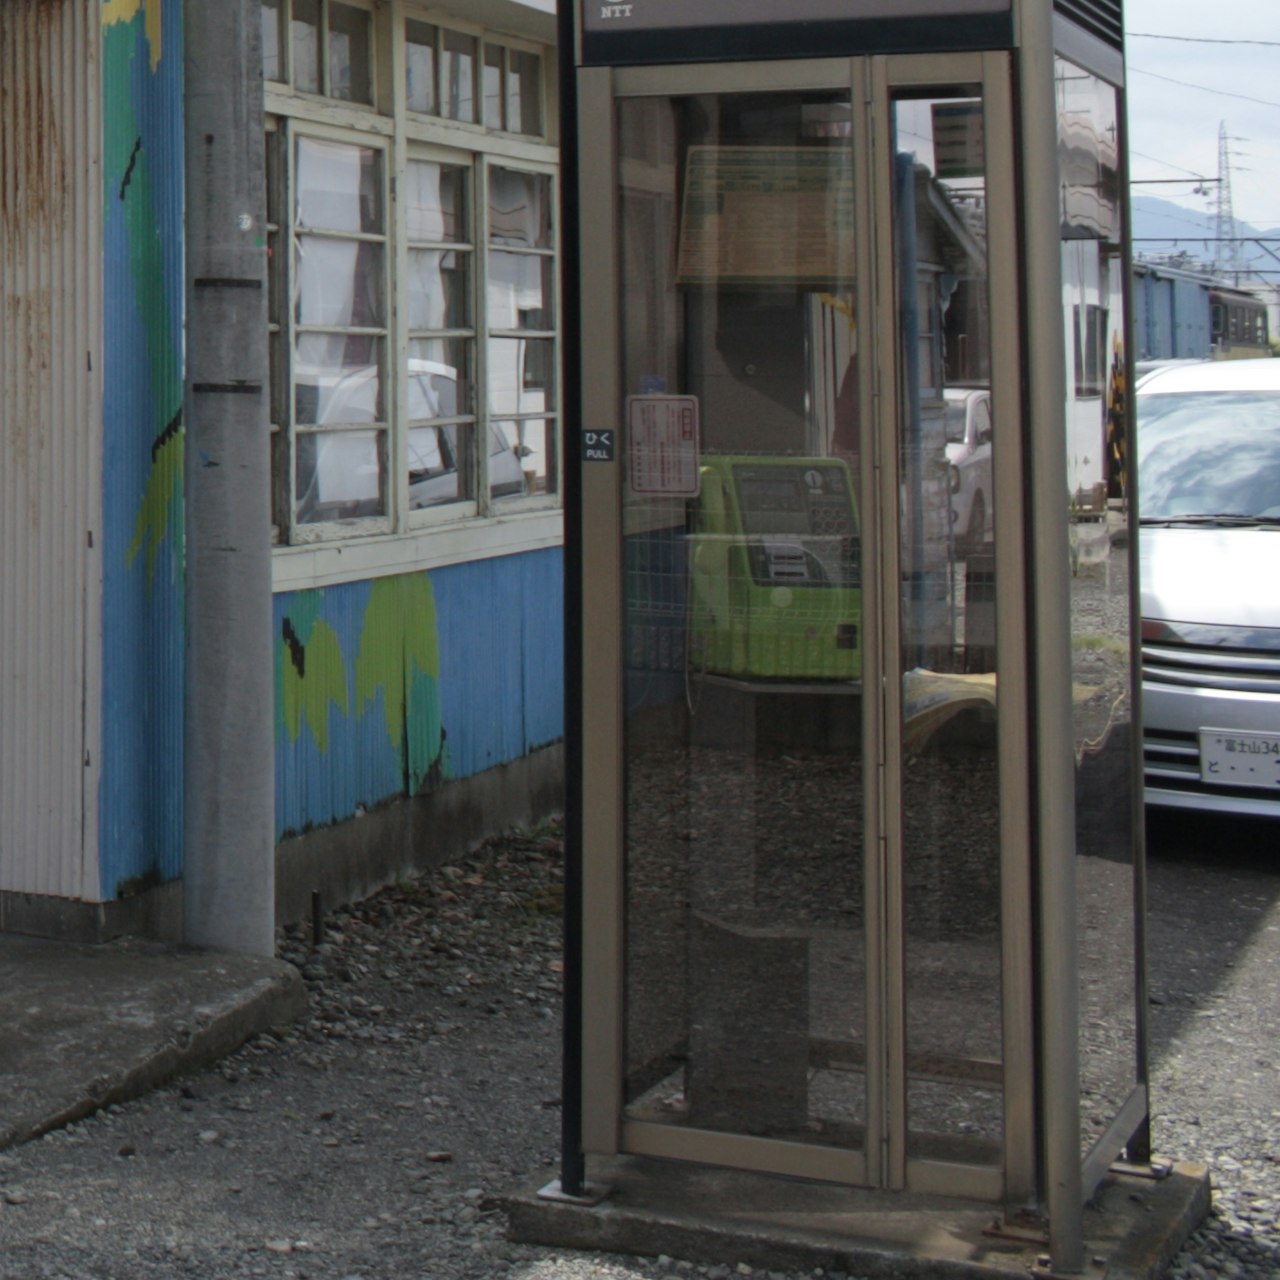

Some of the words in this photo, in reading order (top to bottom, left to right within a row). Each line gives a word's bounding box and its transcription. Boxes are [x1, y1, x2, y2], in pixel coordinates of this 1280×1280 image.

[600, 4, 633, 19] NTT
[584, 432, 611, 445] ひく
[586, 448, 609, 459] PULL
